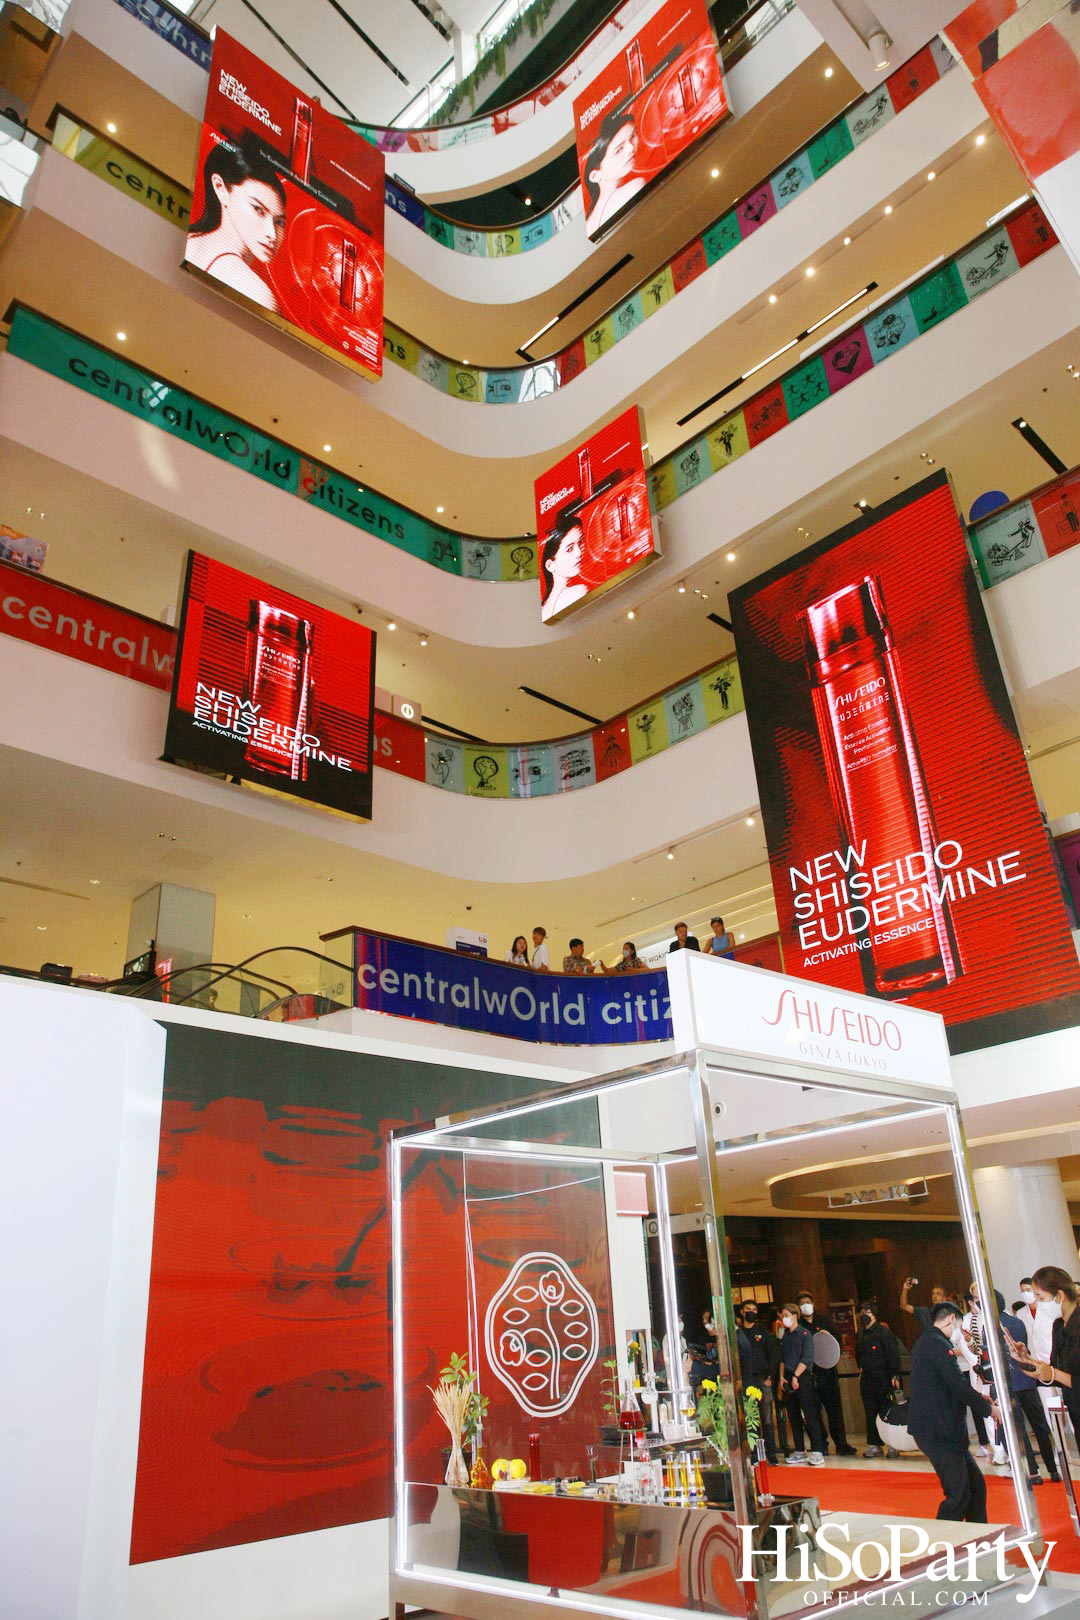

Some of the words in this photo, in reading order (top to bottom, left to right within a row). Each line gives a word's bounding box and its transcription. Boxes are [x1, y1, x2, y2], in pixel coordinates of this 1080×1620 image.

[219, 77, 271, 118] SHISEIDO
[220, 69, 247, 93] NEW
[218, 83, 282, 136] EUDERMINE
[303, 477, 405, 539] citizens
[196, 682, 261, 713] NEW
[835, 676, 886, 709] SHISEIDO
[192, 720, 249, 744] ACTIVATING
[250, 740, 294, 758] ESSENCE
[193, 706, 352, 772] EUDERMINE
[194, 695, 321, 748] SHISEIDO
[789, 839, 867, 892] NEW
[793, 840, 963, 920] SHISEIDO
[798, 850, 1027, 951] EUDERMINE
[803, 937, 872, 967] ACTIVATING
[875, 917, 935, 946] ESSENCE
[357, 963, 586, 1026] centralwOrld
[762, 989, 902, 1051] SHISEIDO
[799, 1042, 842, 1062] GINZA
[847, 1051, 887, 1071] TOKYO
